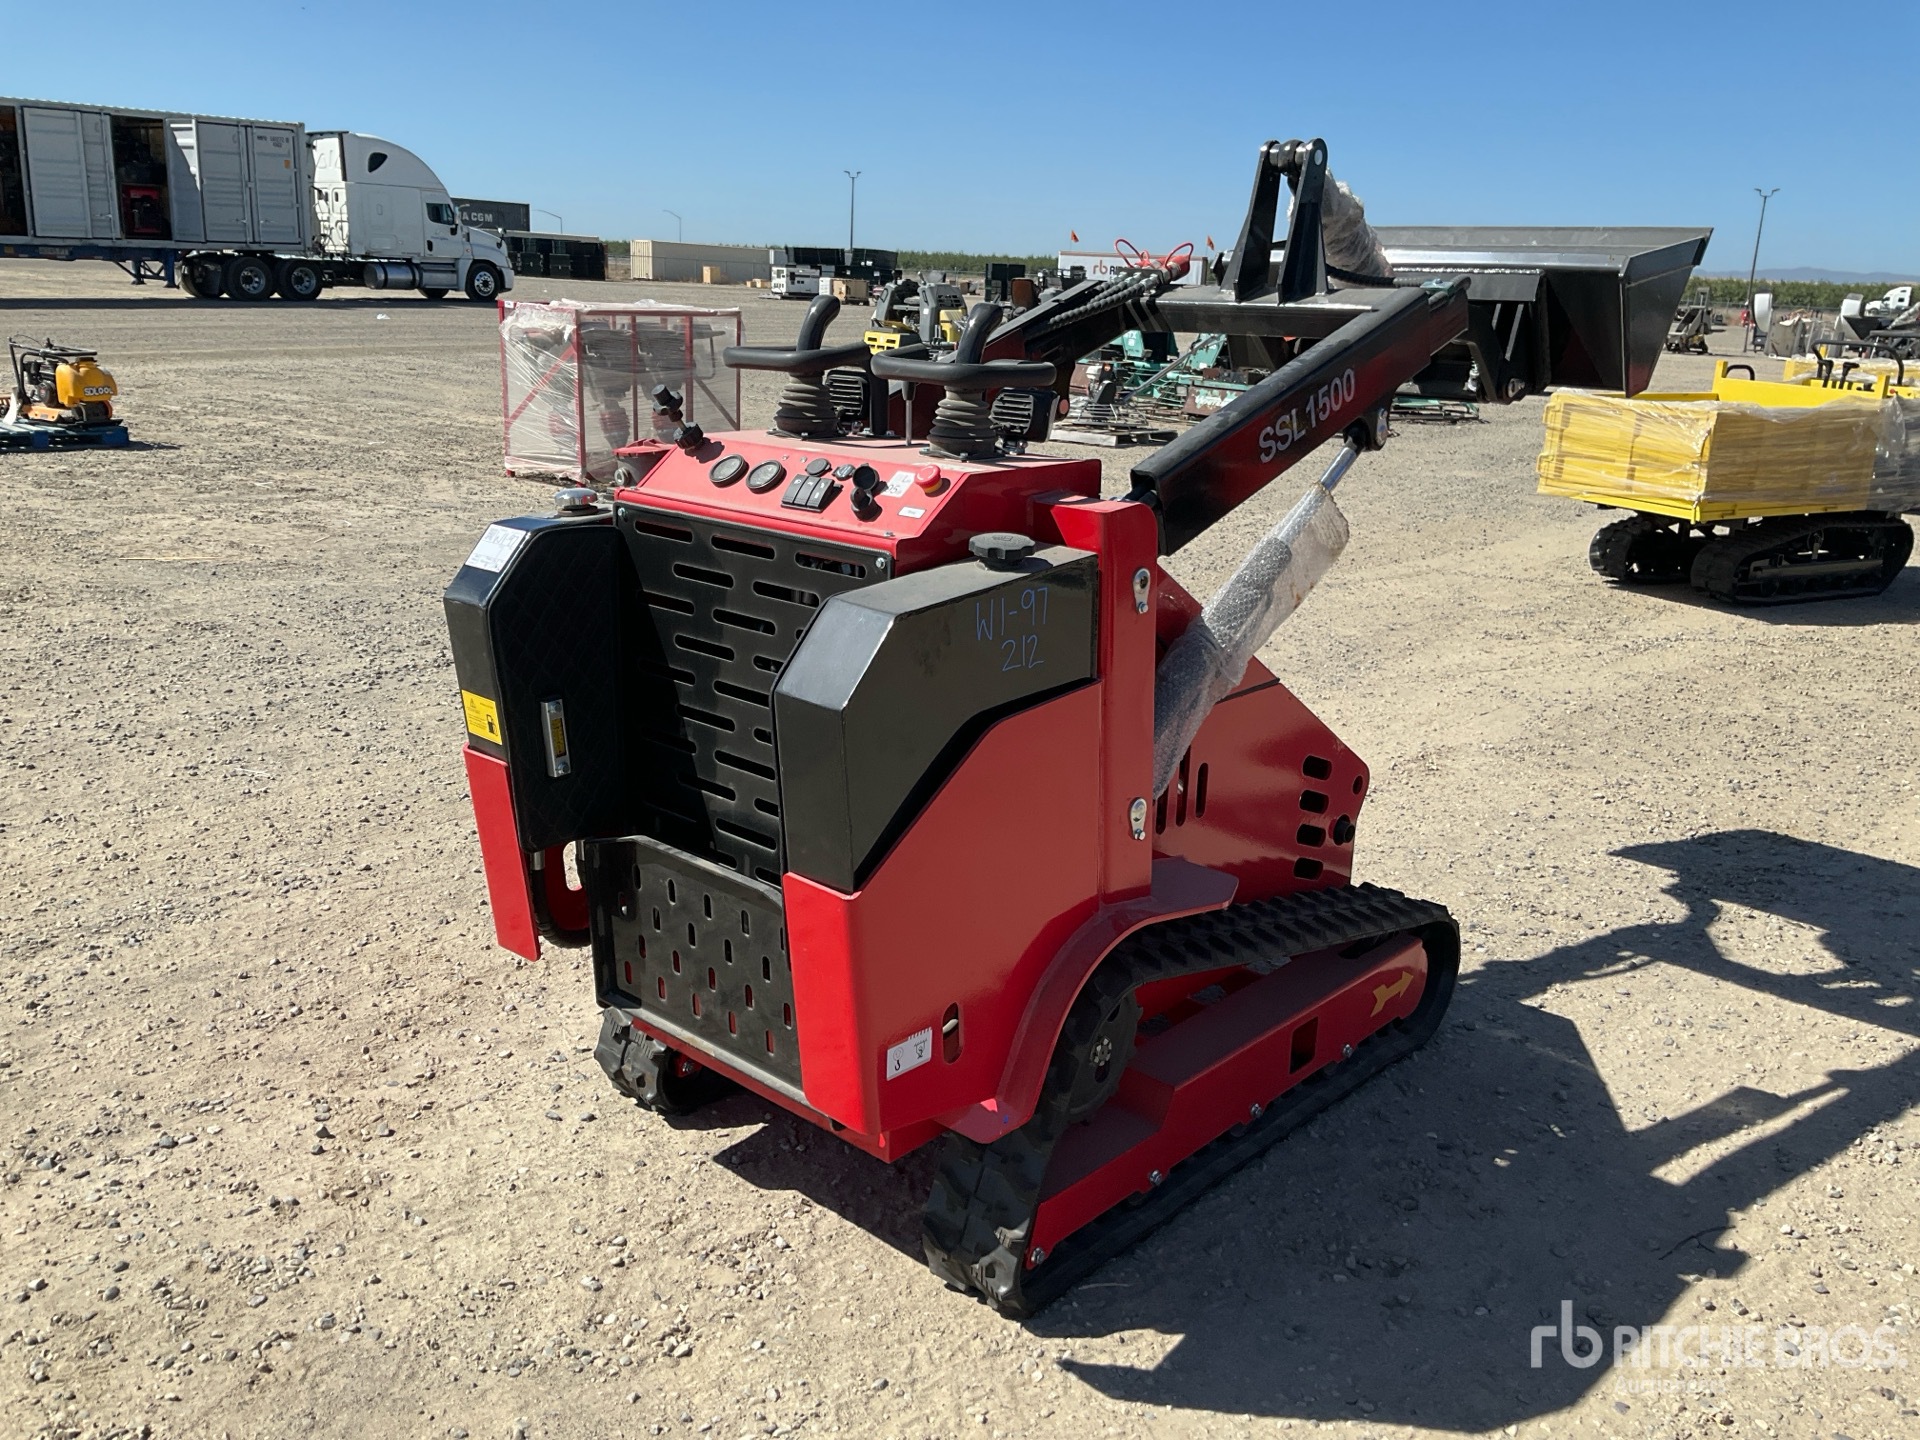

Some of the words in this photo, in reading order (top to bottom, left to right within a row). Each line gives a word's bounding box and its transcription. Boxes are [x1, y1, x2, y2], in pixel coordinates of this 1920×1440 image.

[471, 212, 493, 223] CGM
[1259, 408, 1307, 463] SSL
[1305, 368, 1356, 428] 1500
[1001, 634, 1045, 672] 212
